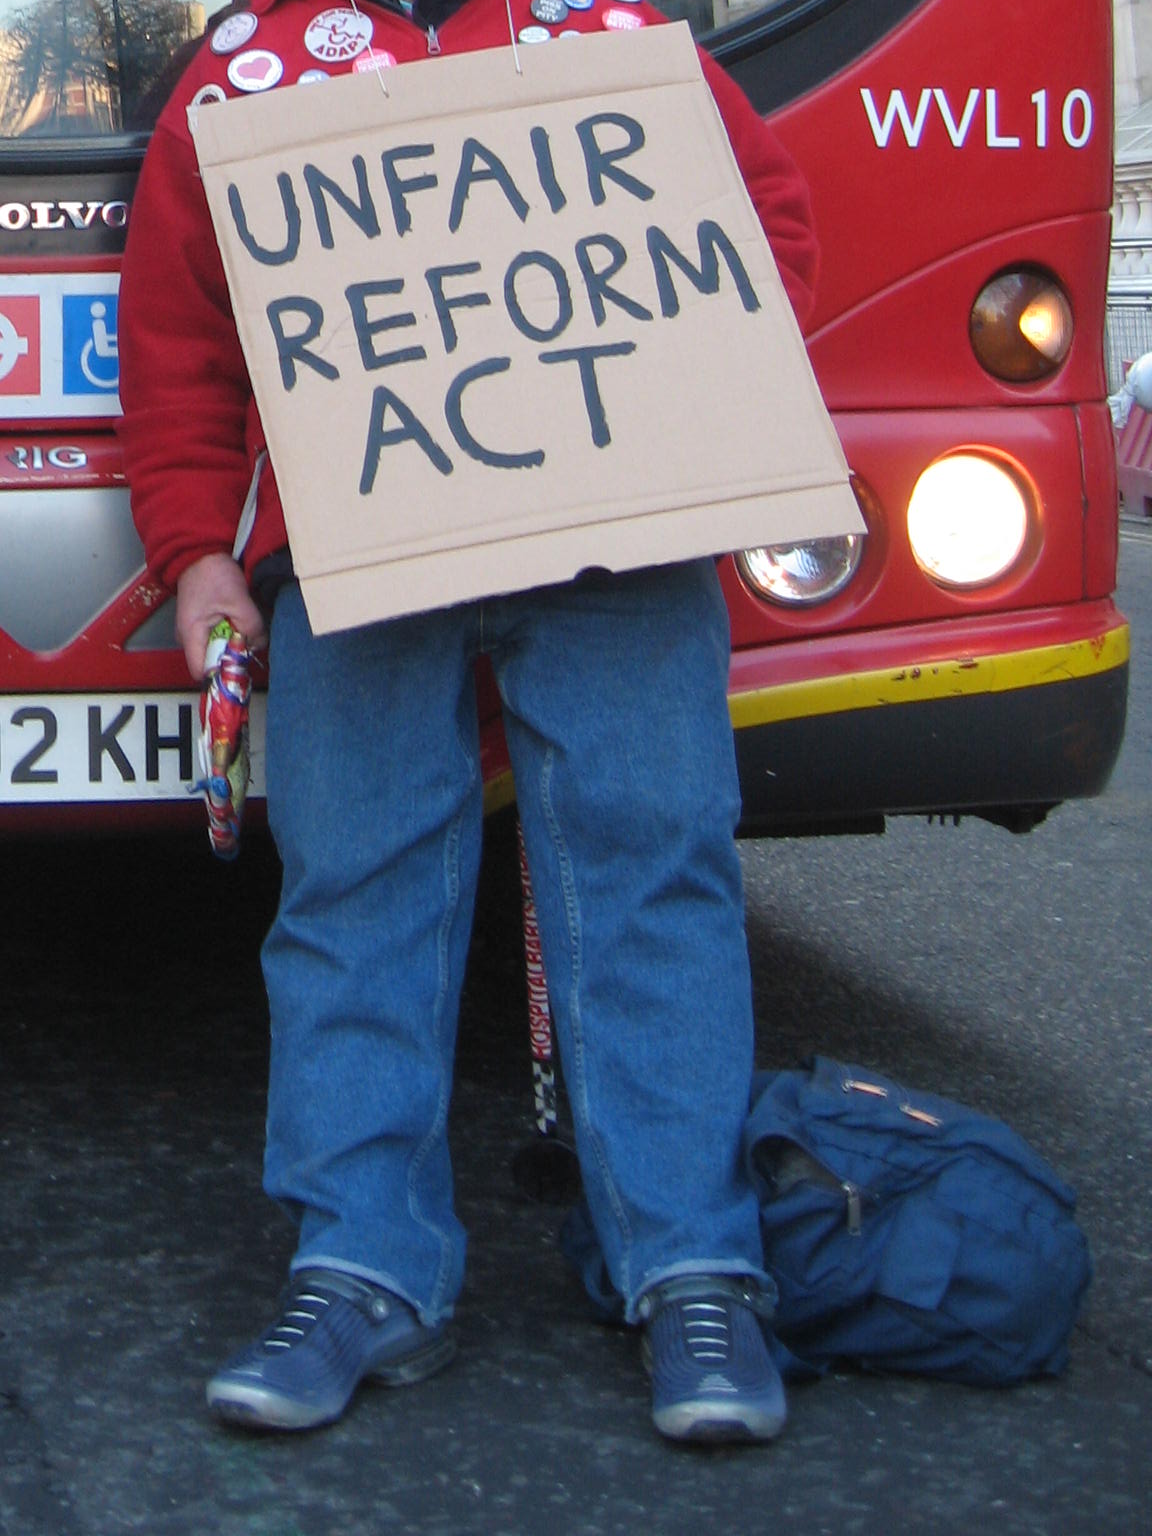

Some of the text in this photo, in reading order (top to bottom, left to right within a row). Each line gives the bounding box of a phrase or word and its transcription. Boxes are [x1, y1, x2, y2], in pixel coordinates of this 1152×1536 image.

[313, 32, 366, 58] ADAPT
[860, 88, 1093, 148] WVL10
[228, 111, 655, 266] UNFAIR
[265, 219, 762, 391] REFORM
[359, 341, 637, 495] ACT
[87, 703, 193, 784] KH
